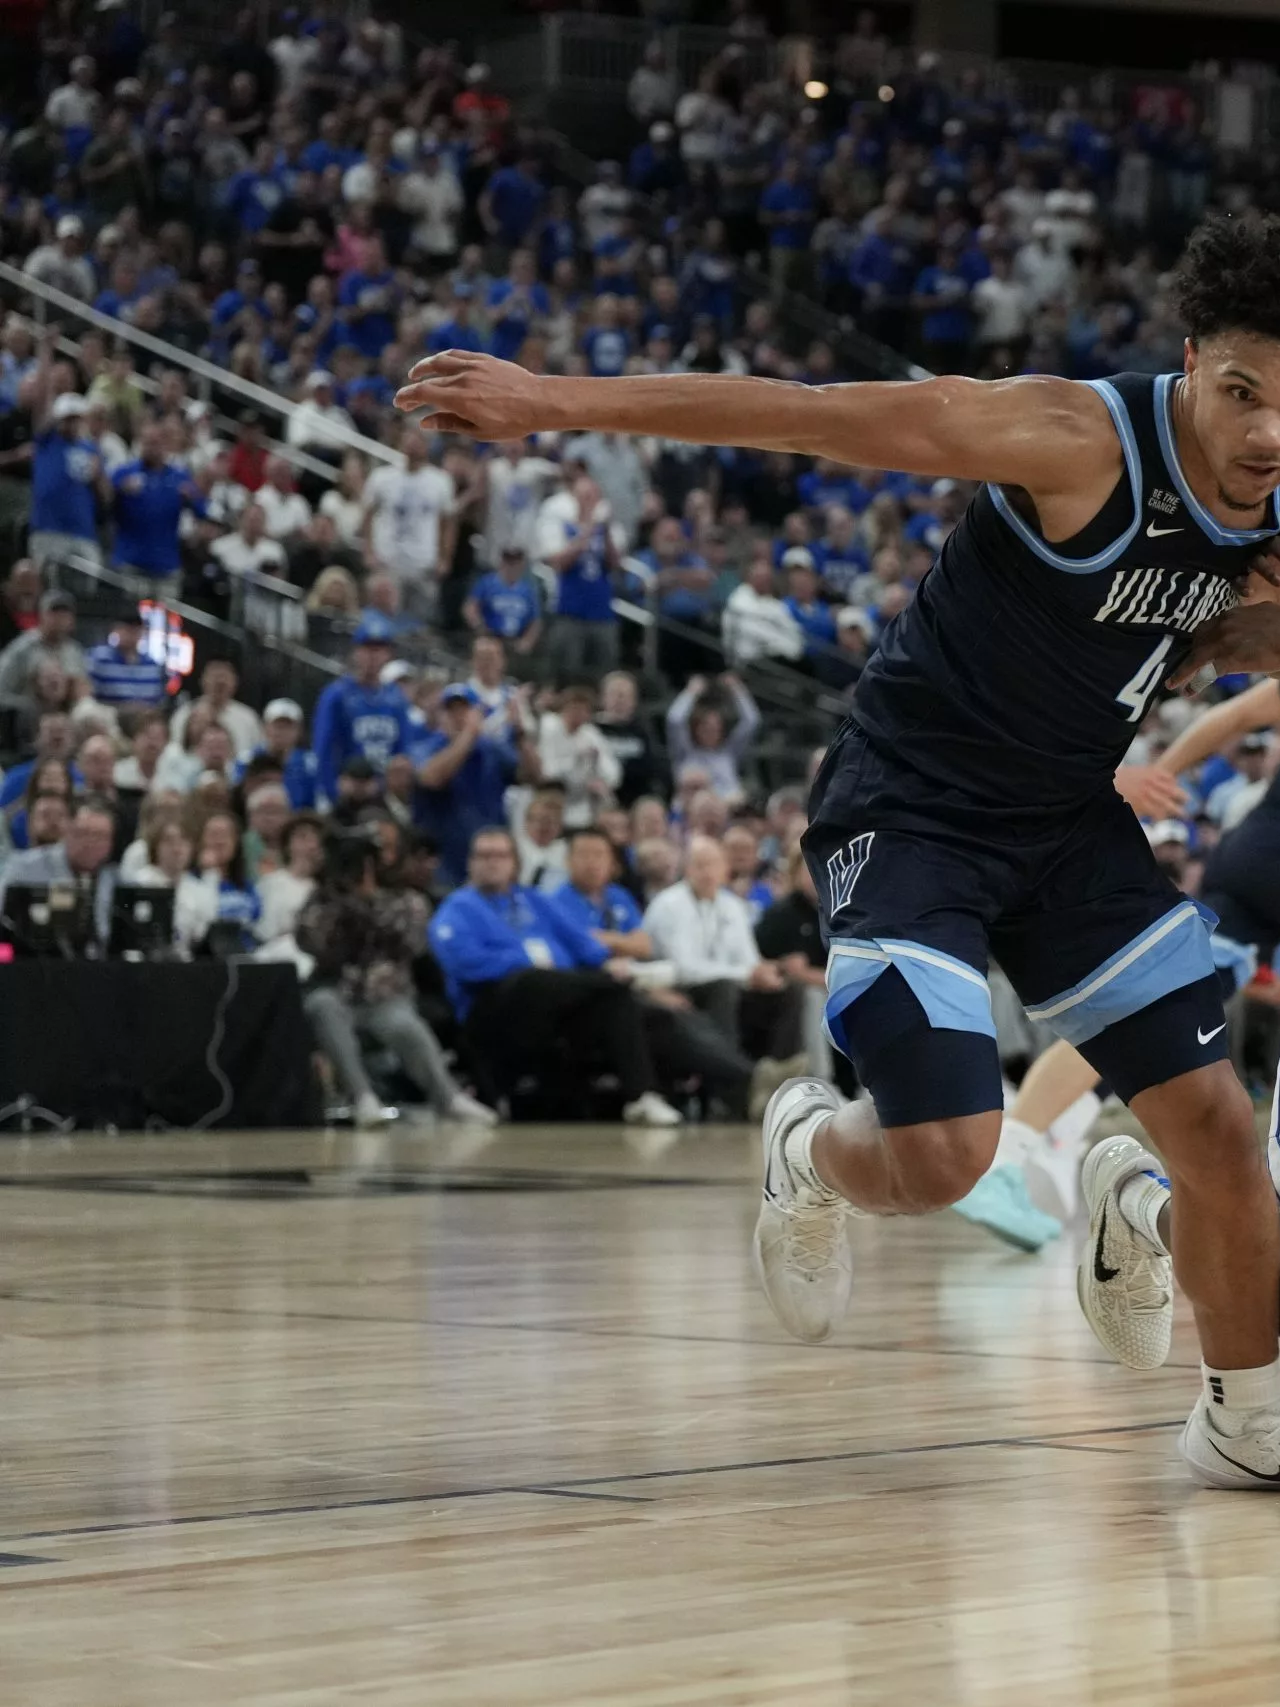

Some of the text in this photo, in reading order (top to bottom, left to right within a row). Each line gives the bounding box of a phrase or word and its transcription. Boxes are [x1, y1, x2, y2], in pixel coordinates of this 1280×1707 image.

[1148, 497, 1177, 515] CHANGE
[1153, 488, 1181, 506] BE THE
[1115, 634, 1175, 722] 4
